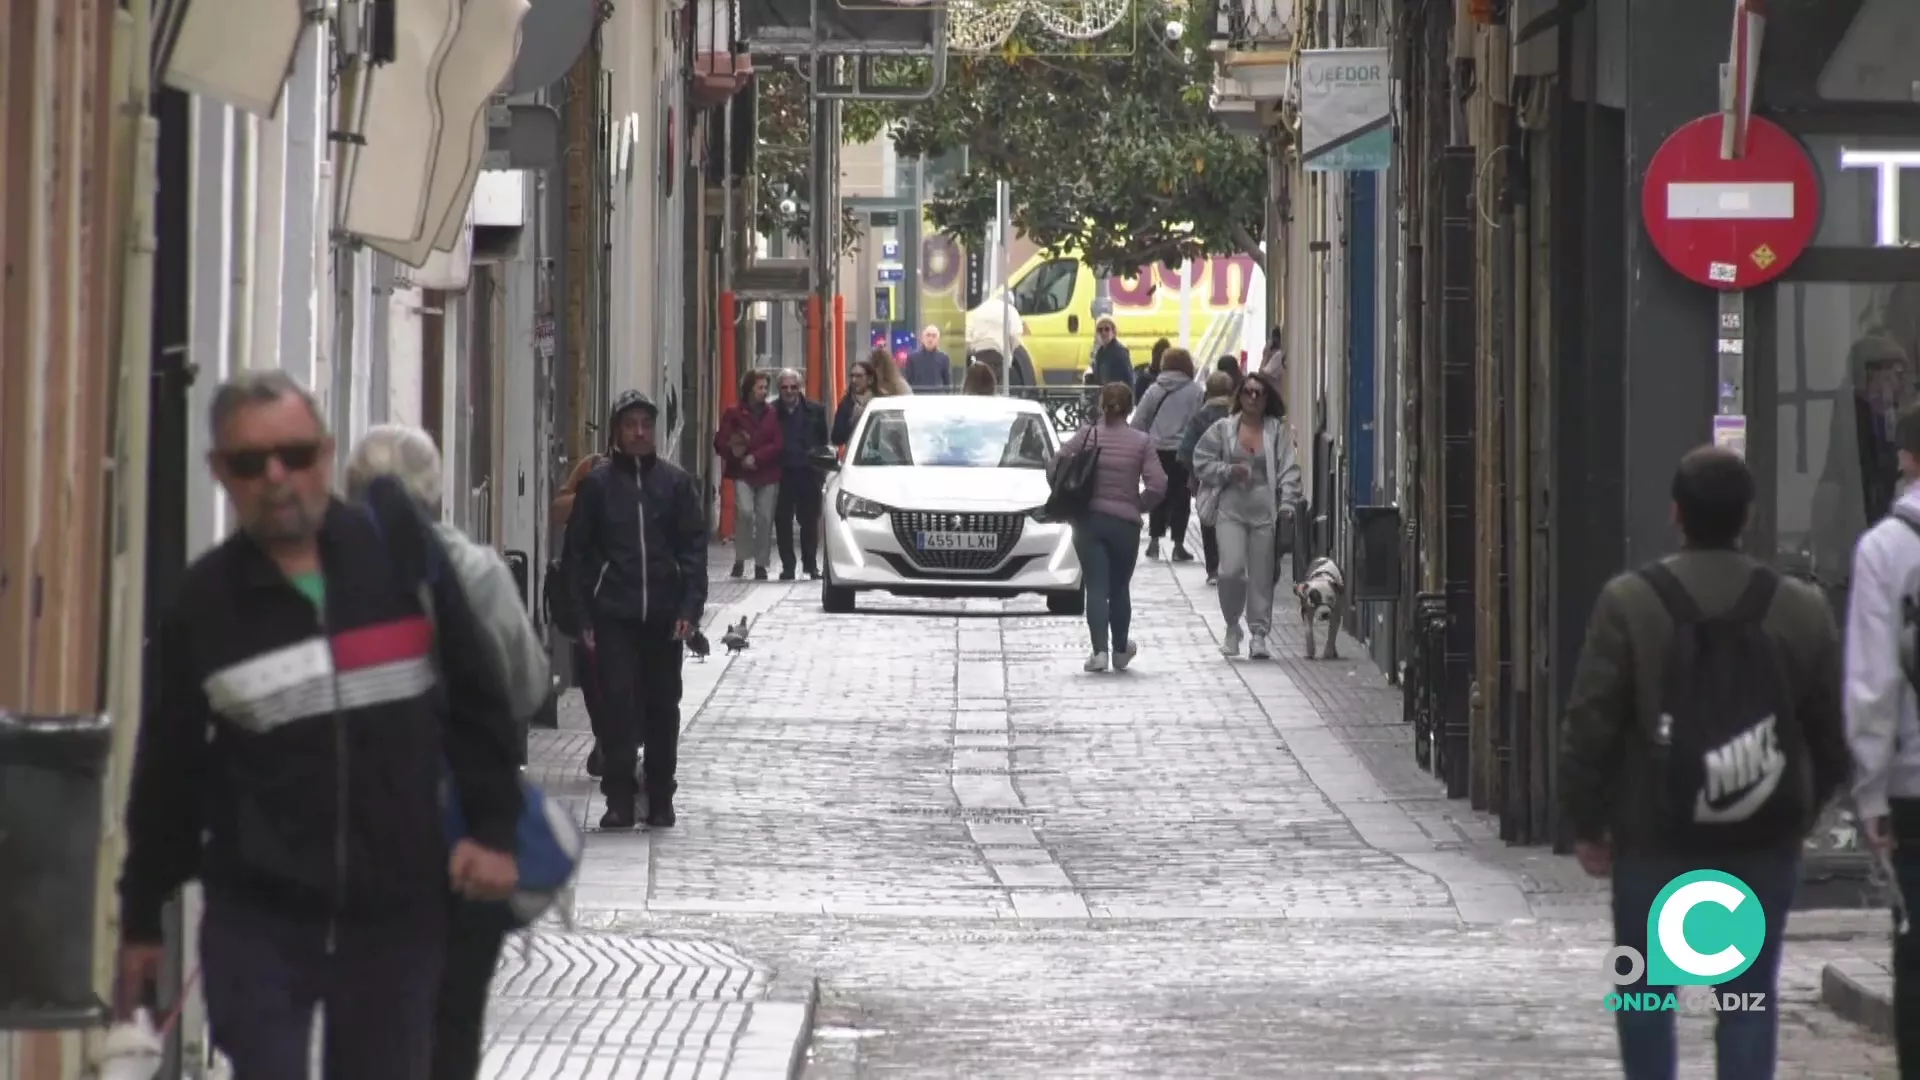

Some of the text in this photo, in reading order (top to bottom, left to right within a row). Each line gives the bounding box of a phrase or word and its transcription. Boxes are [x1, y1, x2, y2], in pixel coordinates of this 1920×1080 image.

[928, 534, 995, 549] 4551 LXH
[1705, 713, 1778, 801] NIKE
